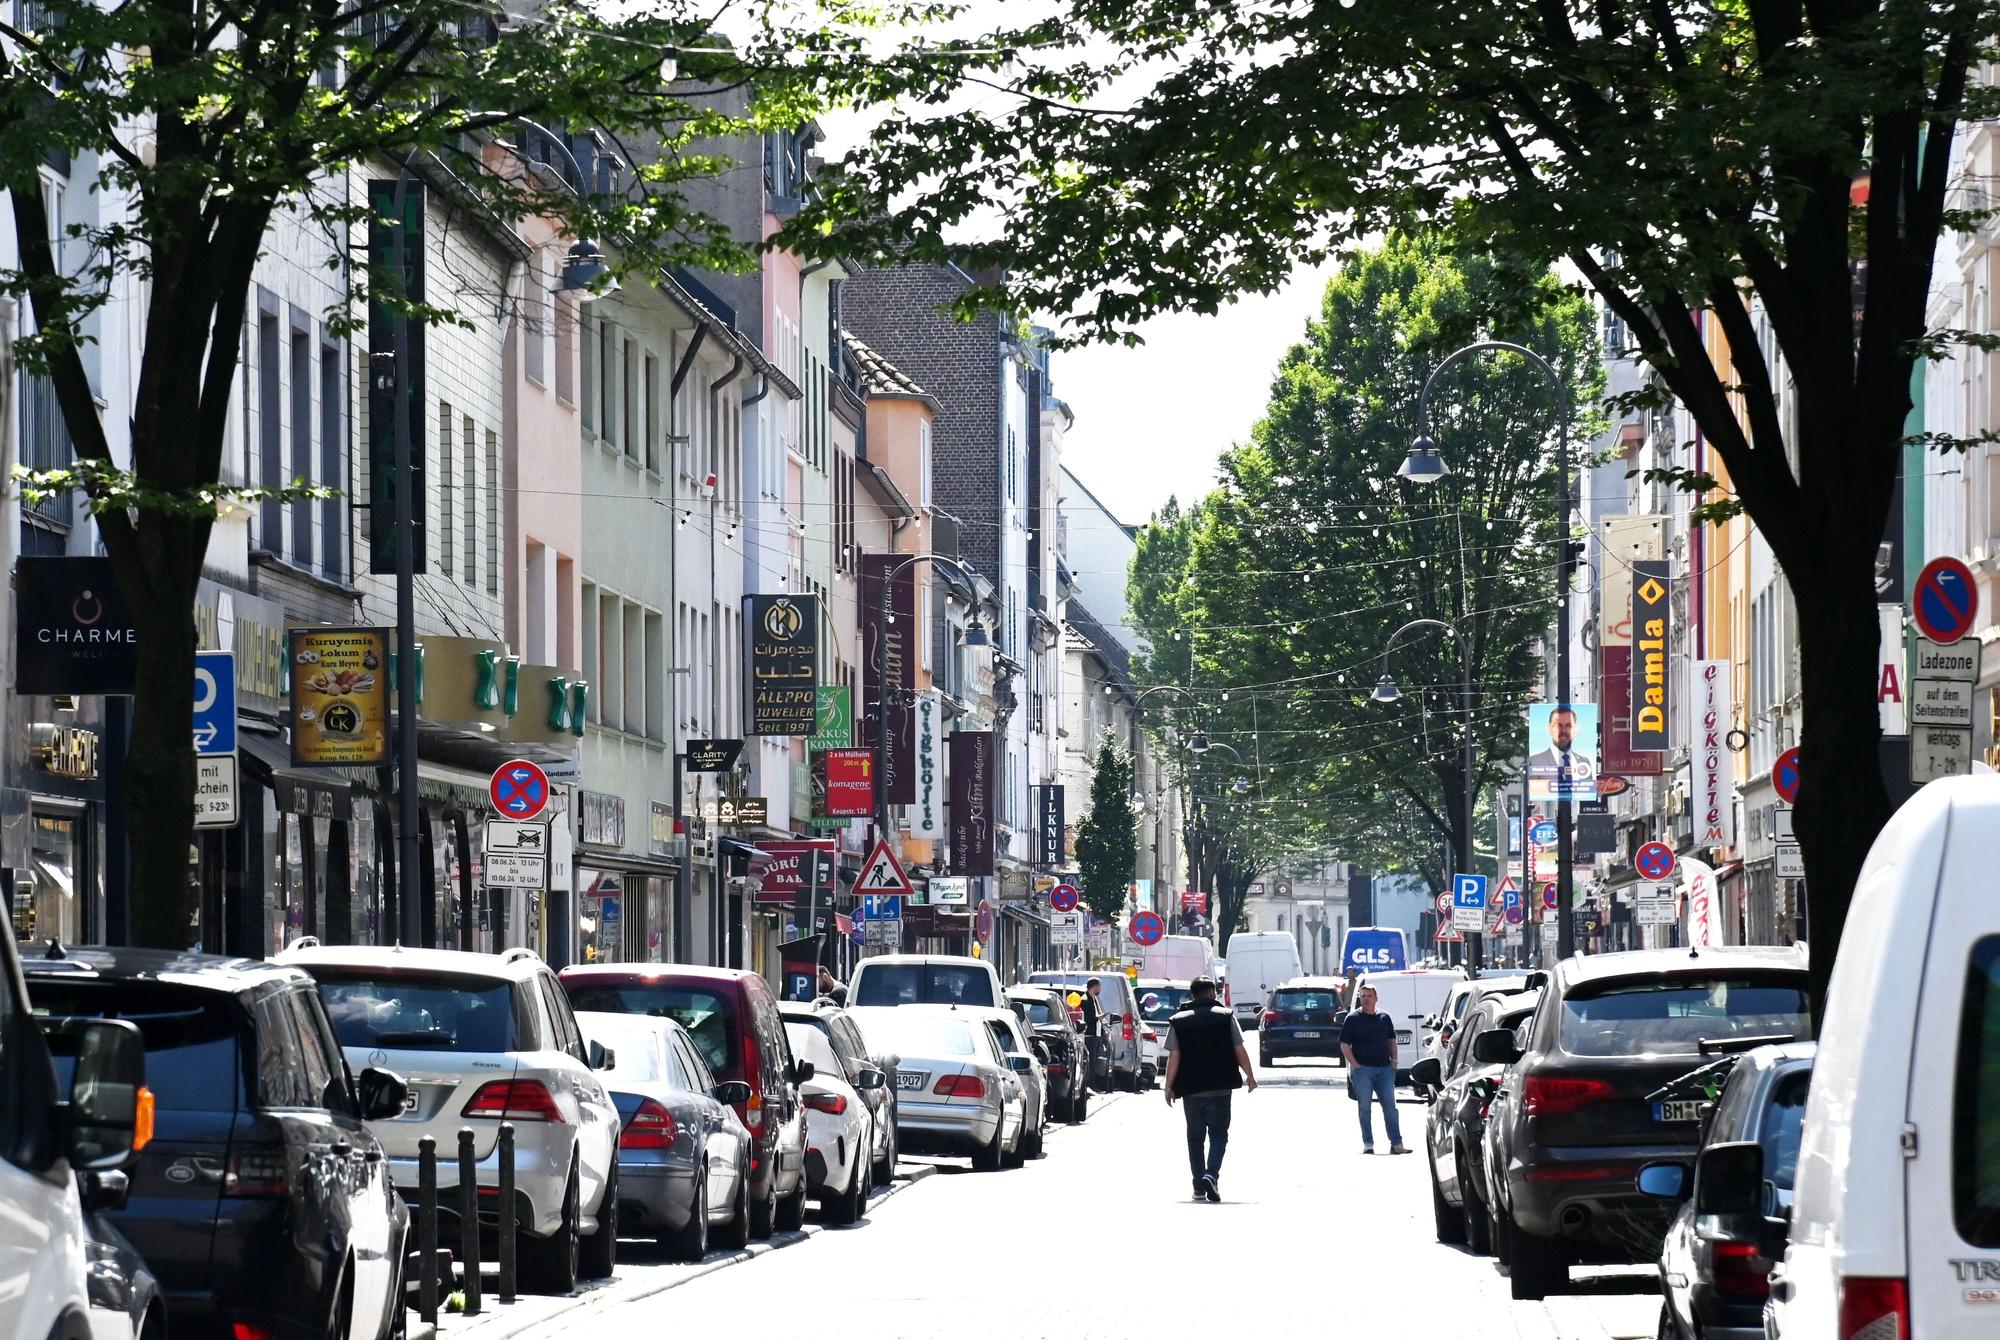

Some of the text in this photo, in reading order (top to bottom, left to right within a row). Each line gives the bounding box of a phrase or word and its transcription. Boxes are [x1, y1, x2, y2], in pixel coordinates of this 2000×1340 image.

[37, 628, 137, 643] CHARME
[305, 637, 374, 648] Kuruyemiş
[754, 642, 815, 657] مجوهرات
[1920, 652, 1973, 670] Ladezone
[1638, 617, 1665, 734] Damla
[756, 691, 814, 703] ALEPPO
[1926, 688, 1959, 700] auf dem
[1915, 704, 1969, 718] Seitenstreifen
[757, 722, 810, 732] Seit 1991
[810, 740, 849, 749] KONYA
[1926, 731, 1961, 749] werktags
[691, 751, 728, 759] CLARITY
[1630, 758, 1653, 766] 1970
[1928, 756, 1935, 772] 7
[201, 765, 219, 777] mit
[828, 779, 870, 789] komagene
[209, 802, 230, 813] 9-23h
[1536, 830, 1558, 839] EFES
[1663, 1103, 1684, 1120] BM
